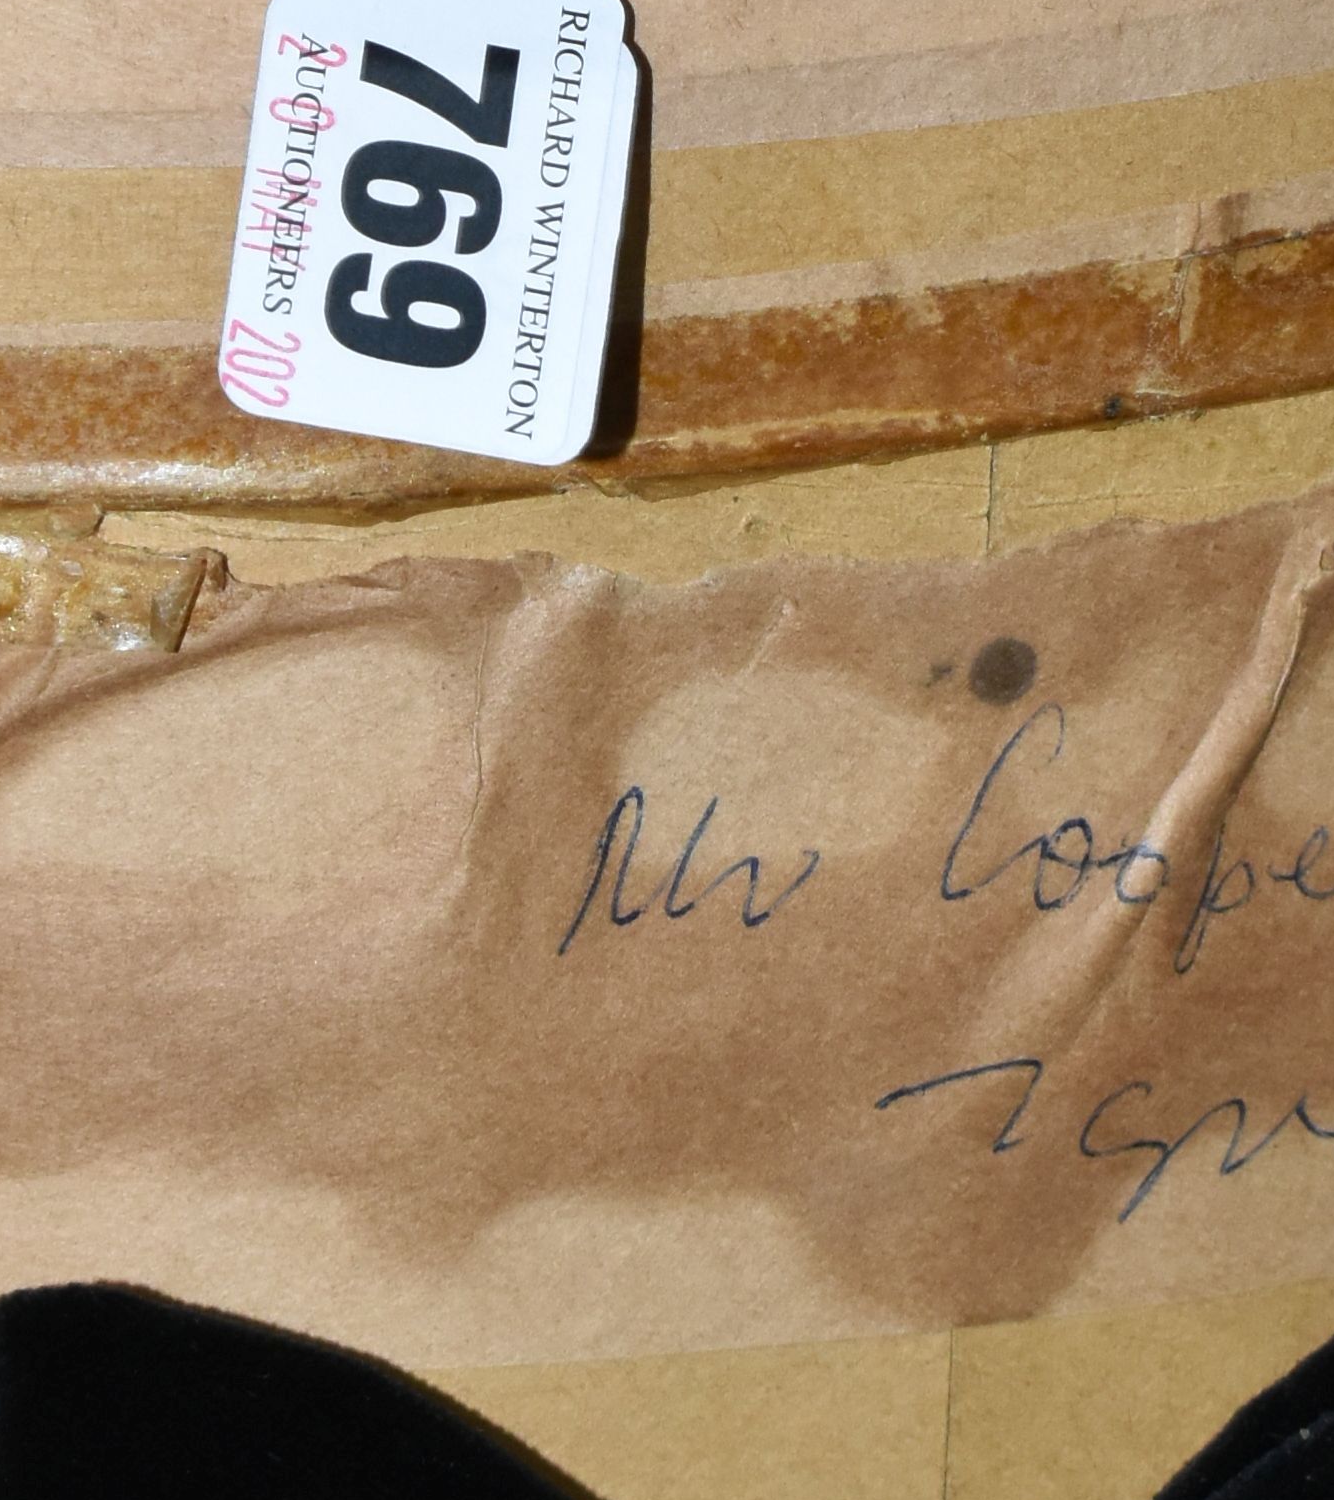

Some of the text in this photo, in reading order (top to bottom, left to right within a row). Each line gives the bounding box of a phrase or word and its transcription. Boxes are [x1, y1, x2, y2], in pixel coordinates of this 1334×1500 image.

[262, 32, 330, 315] AUCTIONEERS
[324, 38, 521, 370] 769
[503, 6, 591, 440] RICHARD WINTERTON
